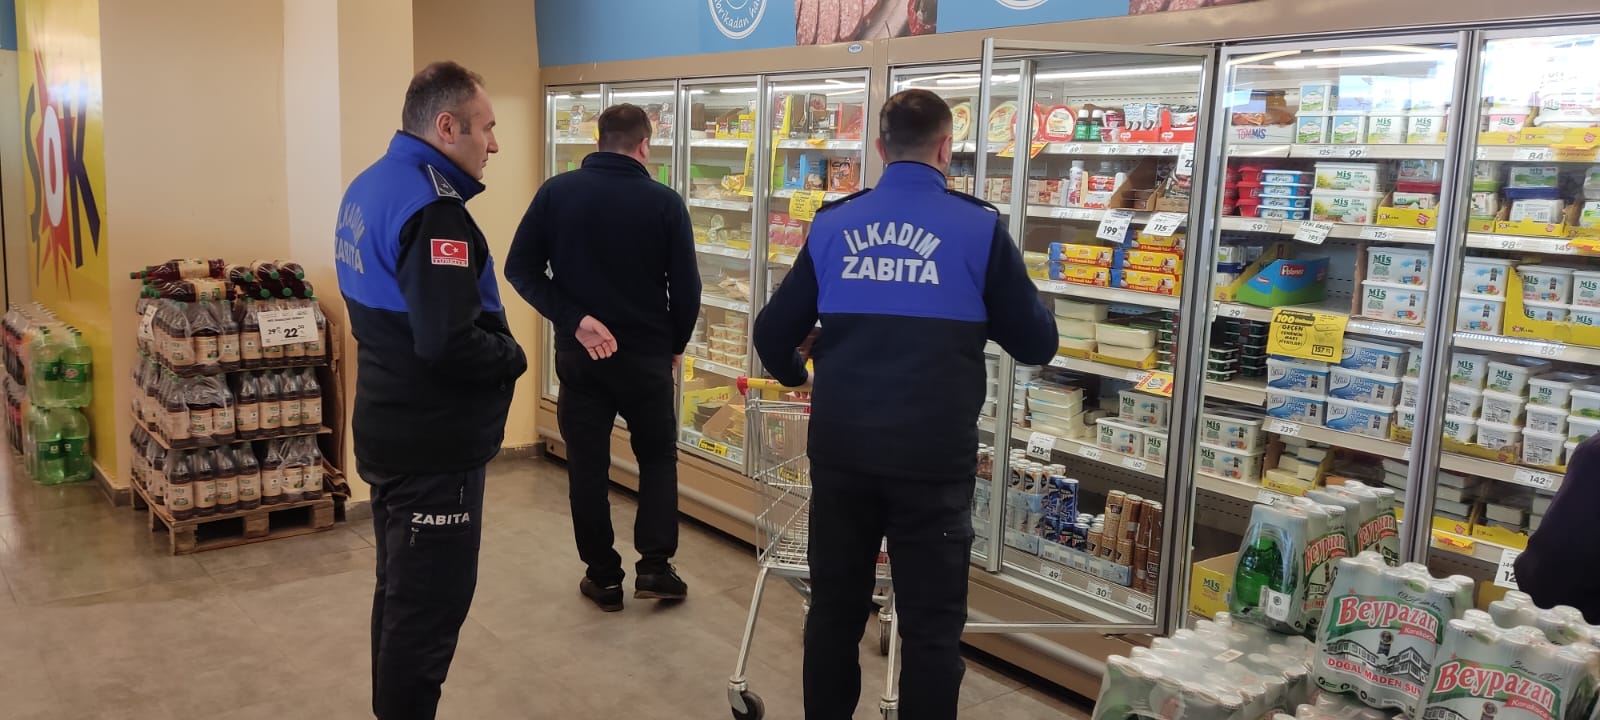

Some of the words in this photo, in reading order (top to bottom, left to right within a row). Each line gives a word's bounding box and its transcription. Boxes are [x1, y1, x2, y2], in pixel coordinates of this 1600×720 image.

[1528, 152, 1544, 161] 84
[1103, 225, 1117, 236] 199
[1154, 224, 1168, 232] 115
[843, 221, 942, 260] İLKADIM
[1501, 240, 1516, 249] 98
[841, 256, 940, 285] ZABITA
[1277, 314, 1295, 324] 100
[283, 327, 299, 338] 22
[1032, 445, 1045, 456] 275
[1530, 475, 1546, 485] 142
[411, 512, 470, 526] ZABITA
[1048, 570, 1059, 579] 49
[1095, 587, 1107, 597] 30
[1136, 602, 1148, 613] 40
[1335, 596, 1439, 639] Beypazarı
[1363, 670, 1402, 688] MADEN
[1431, 659, 1556, 711] Beypazarı
